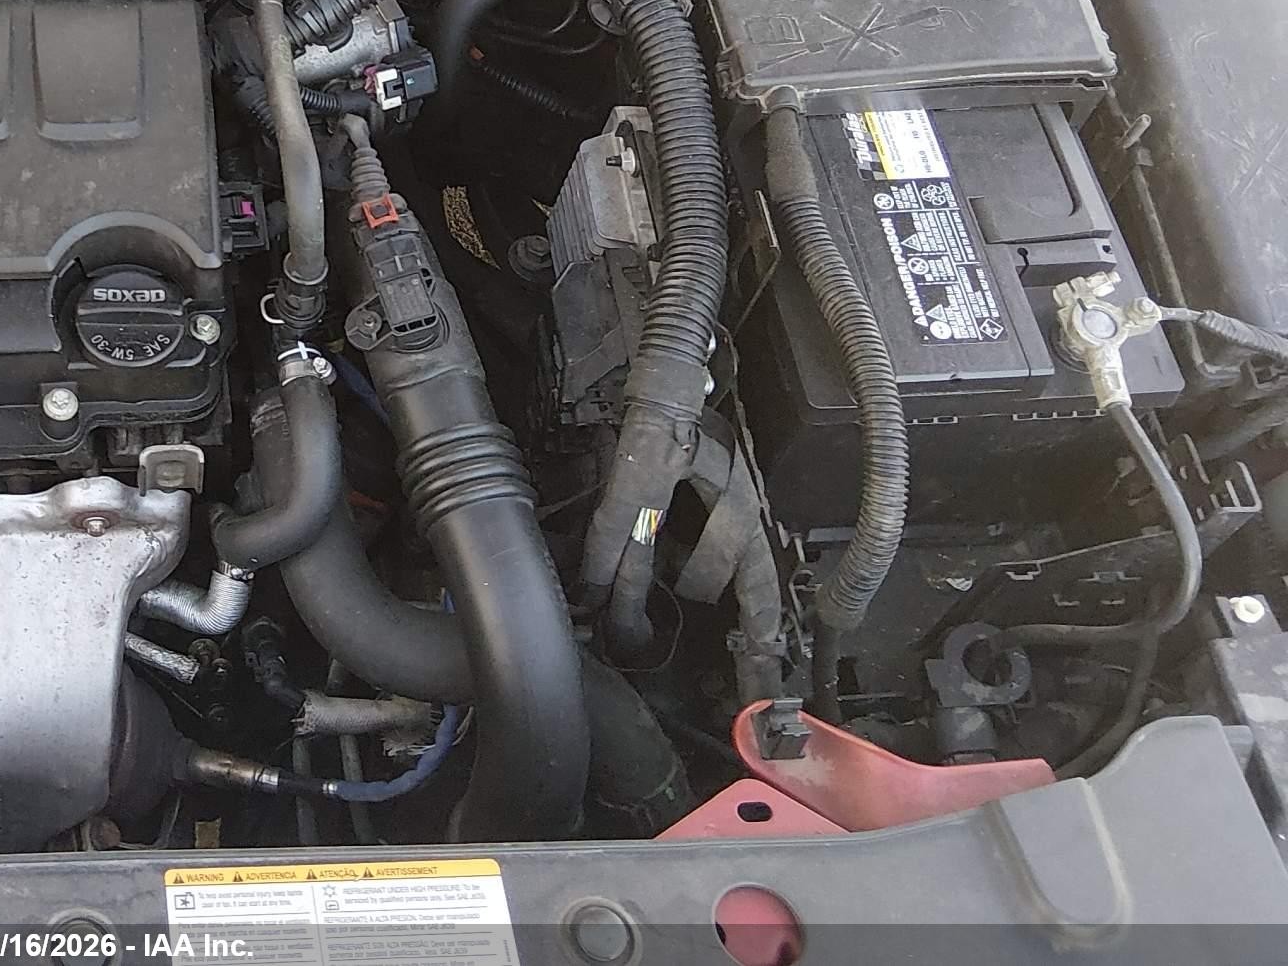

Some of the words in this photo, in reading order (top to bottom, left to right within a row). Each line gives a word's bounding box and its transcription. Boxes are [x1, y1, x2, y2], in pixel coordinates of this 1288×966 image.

[845, 112, 872, 163] Duralas
[880, 217, 924, 315] DANGER/POISON
[93, 288, 166, 302] dexos
[90, 334, 135, 361] 5W-30
[142, 334, 171, 357] SAE
[186, 872, 224, 882] WARNING
[245, 871, 297, 881] ADVERTENCIA
[375, 867, 439, 876] AVERTISSEMENT
